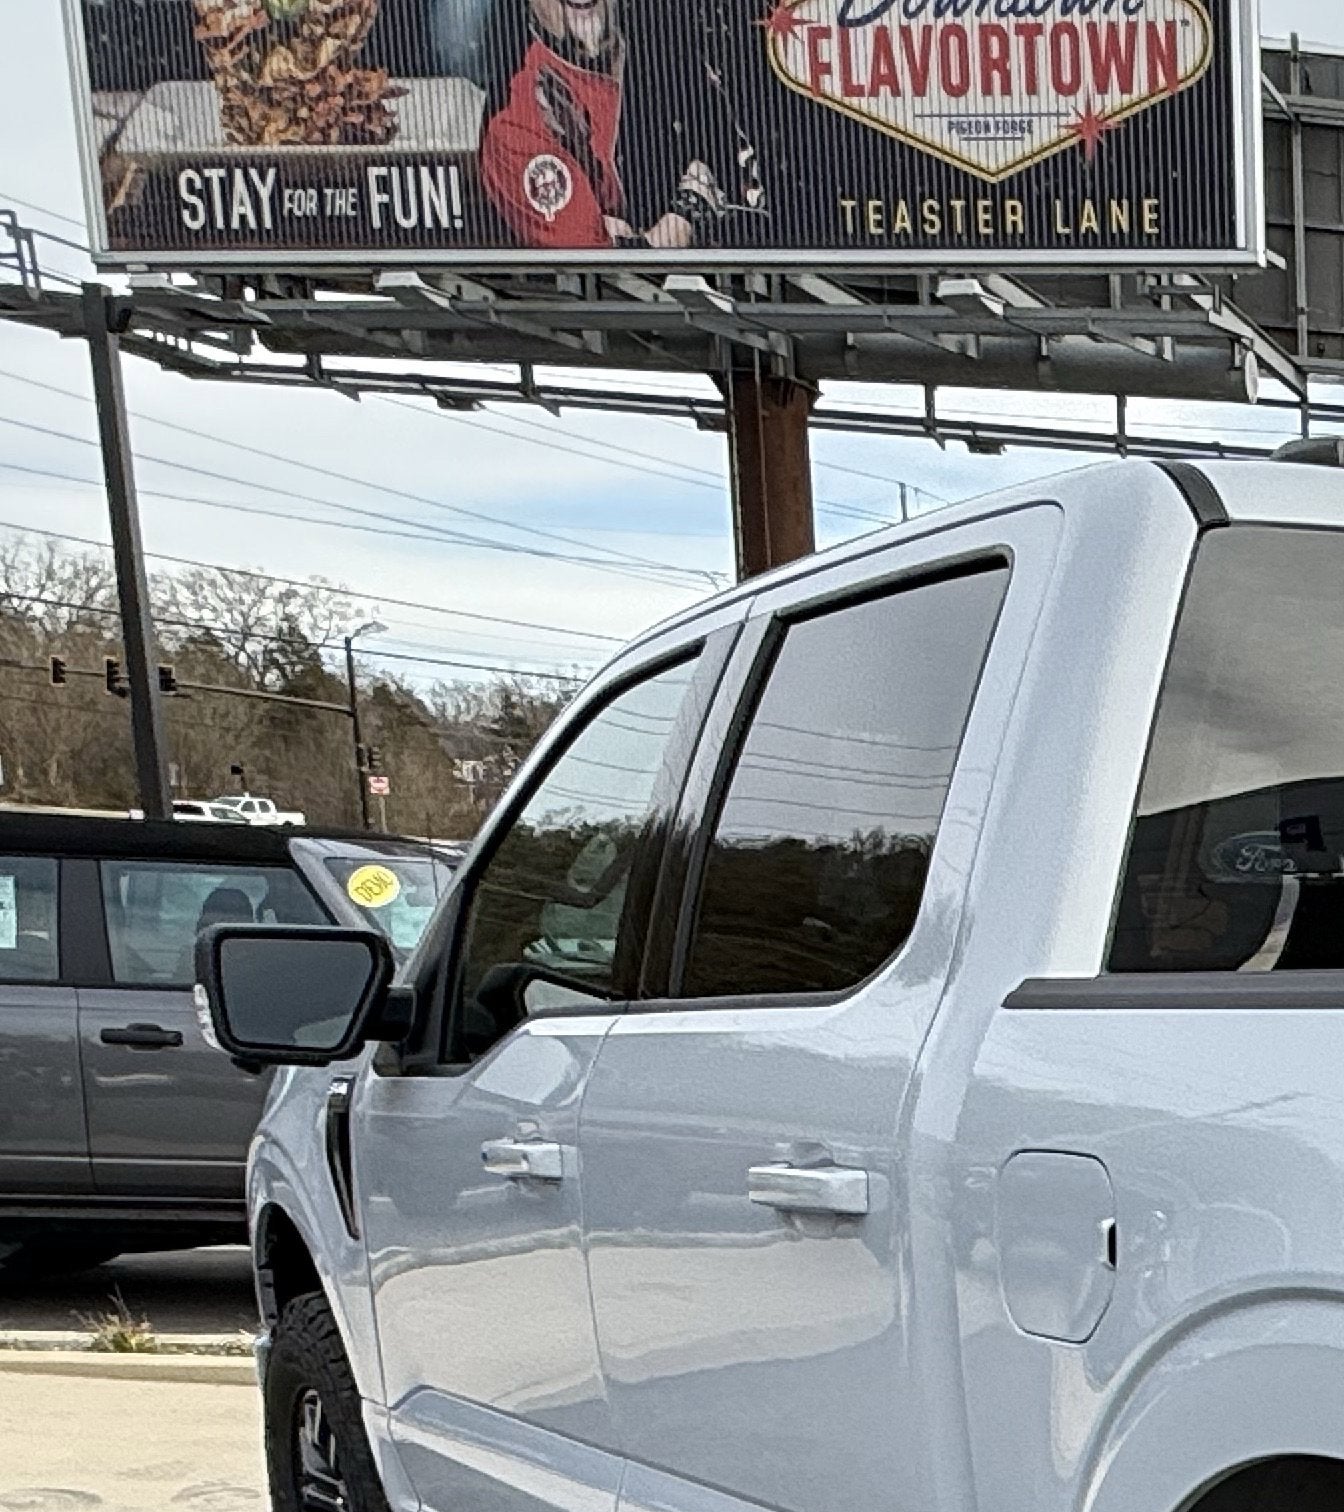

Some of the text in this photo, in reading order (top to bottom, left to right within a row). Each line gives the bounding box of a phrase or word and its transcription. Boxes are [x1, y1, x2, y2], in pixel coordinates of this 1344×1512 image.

[807, 20, 1179, 98] FLAVORTOWN
[178, 166, 464, 230] STAY FOR THE FUN!
[841, 198, 1160, 235] TEASTER LANE
